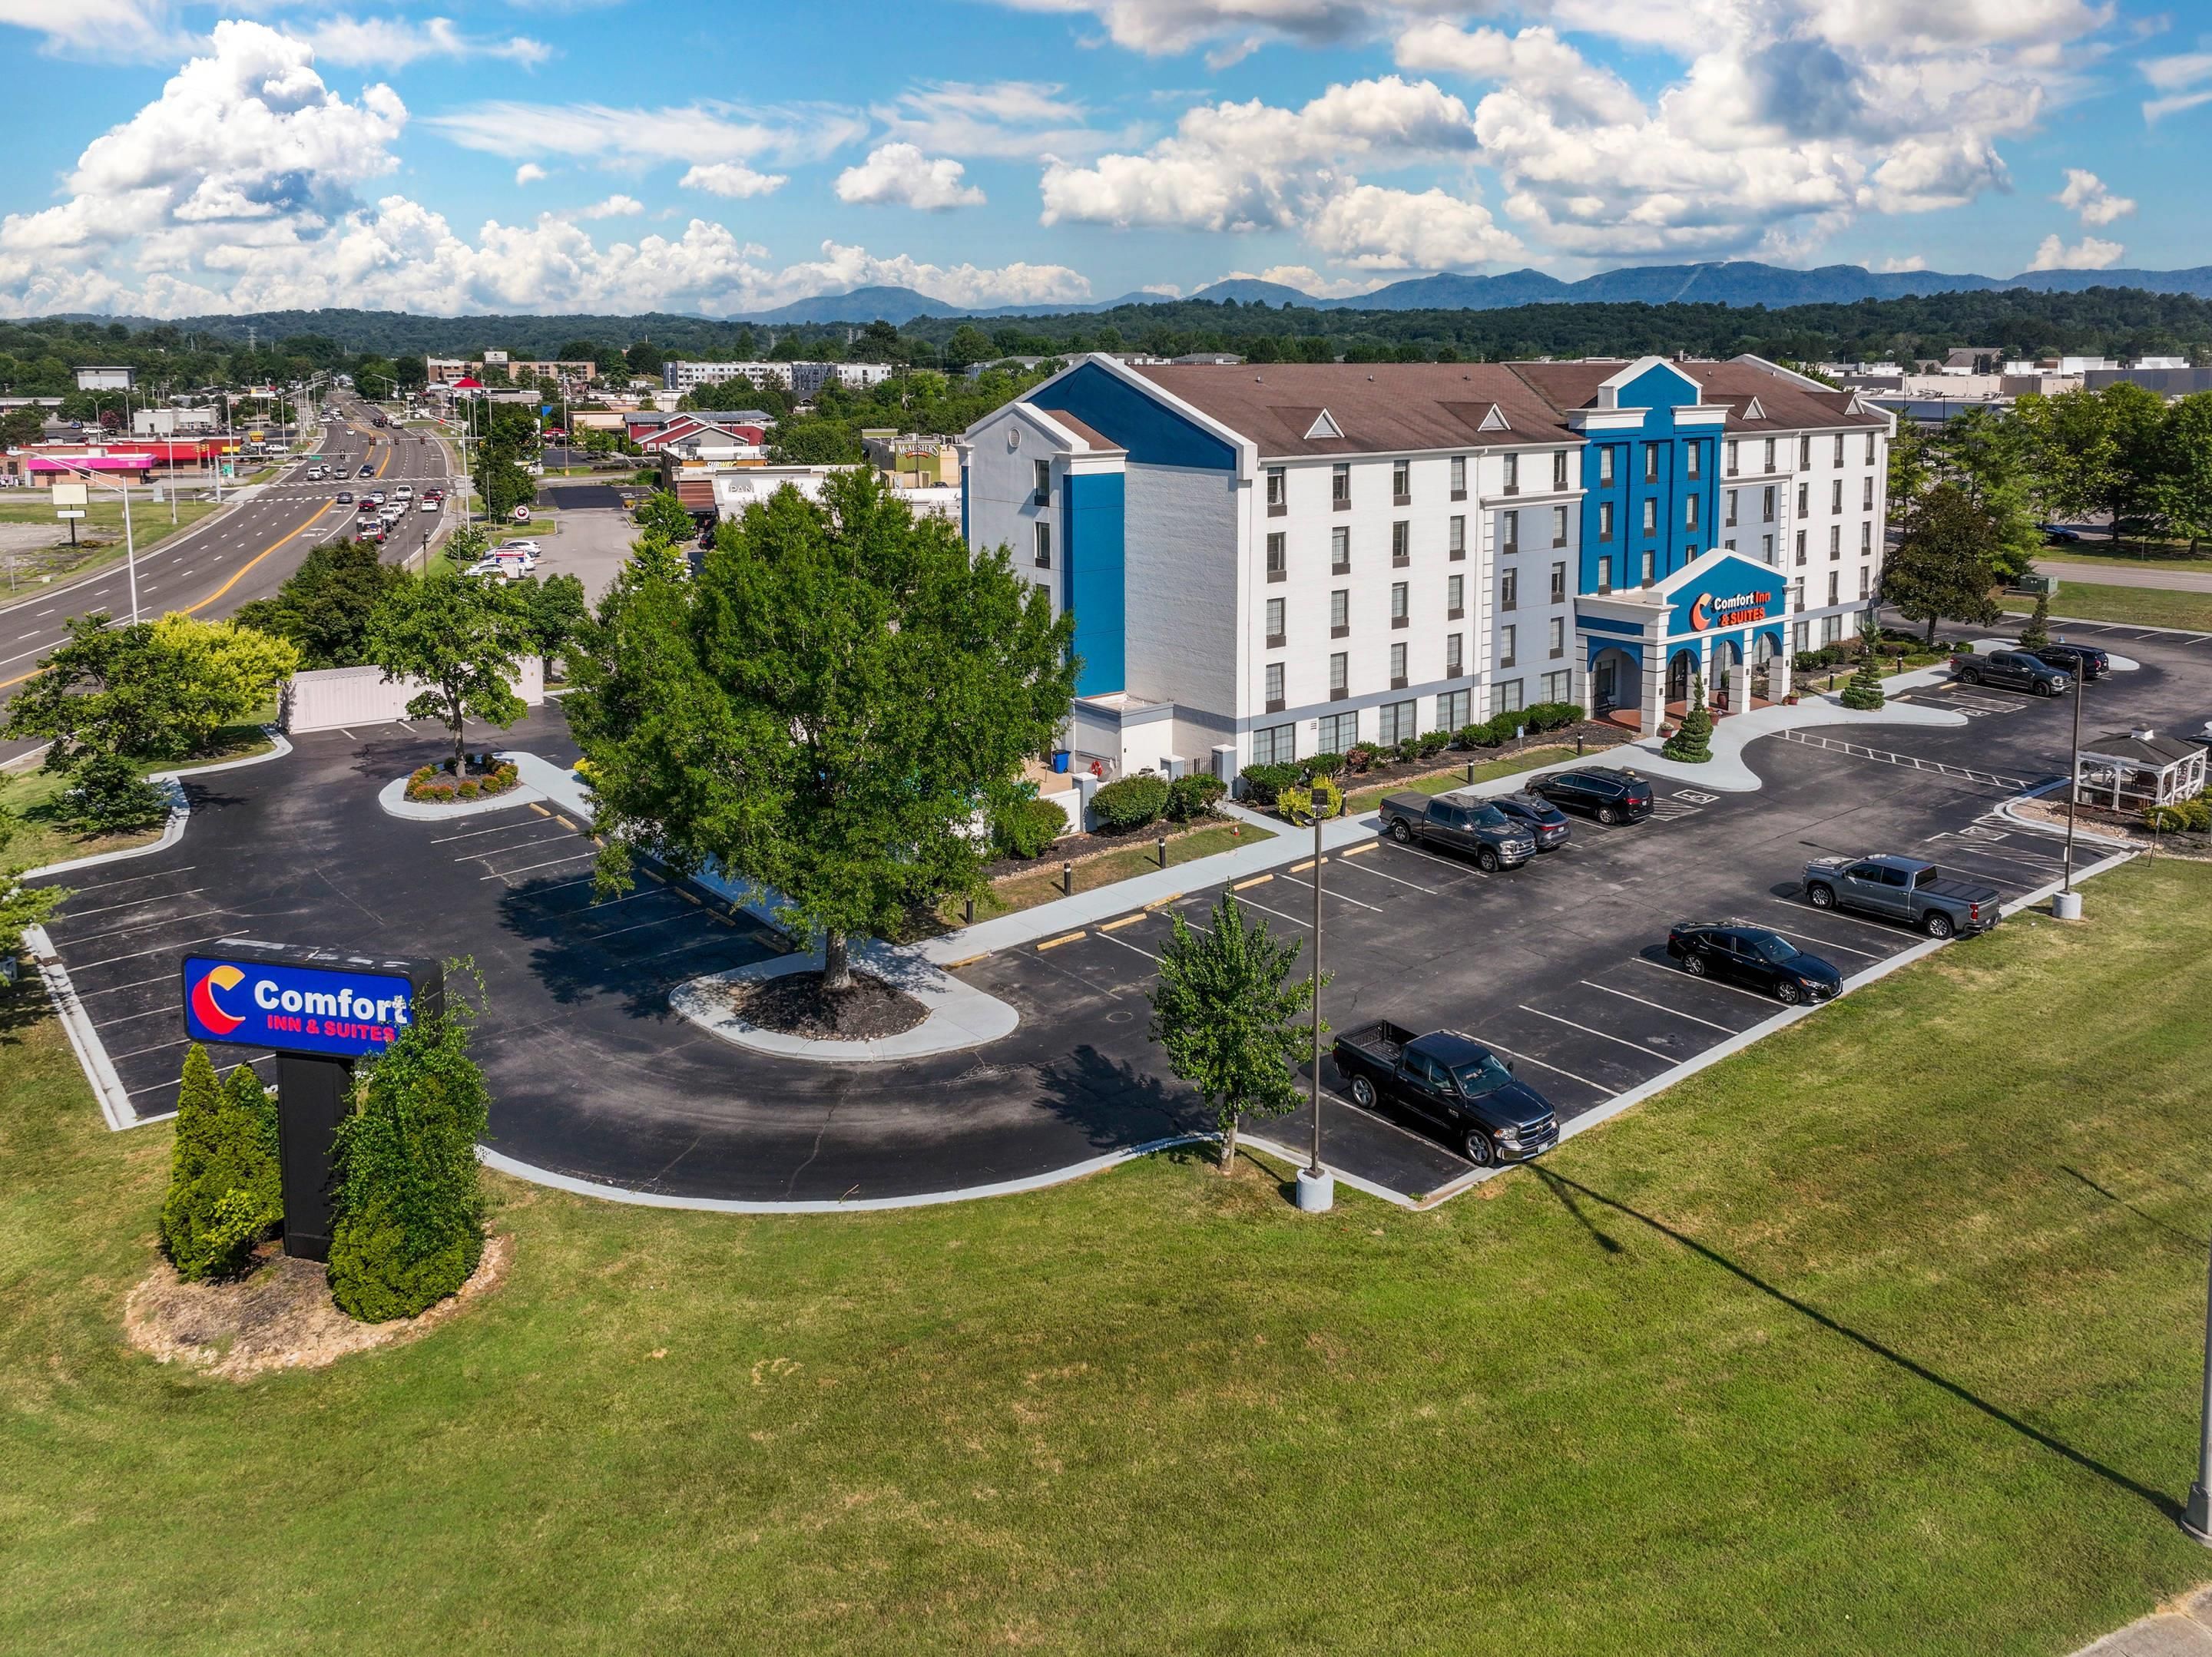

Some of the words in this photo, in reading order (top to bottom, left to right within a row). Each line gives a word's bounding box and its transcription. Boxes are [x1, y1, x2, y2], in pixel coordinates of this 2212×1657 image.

[1714, 592, 1754, 610] Comfort
[1755, 590, 1771, 604] Inn
[1721, 614, 1729, 626] &
[1730, 607, 1766, 624] SUITES
[254, 980, 408, 1024] Comfort
[267, 1014, 302, 1033] INN
[306, 1019, 320, 1034] &
[324, 1020, 396, 1043] SUITES
